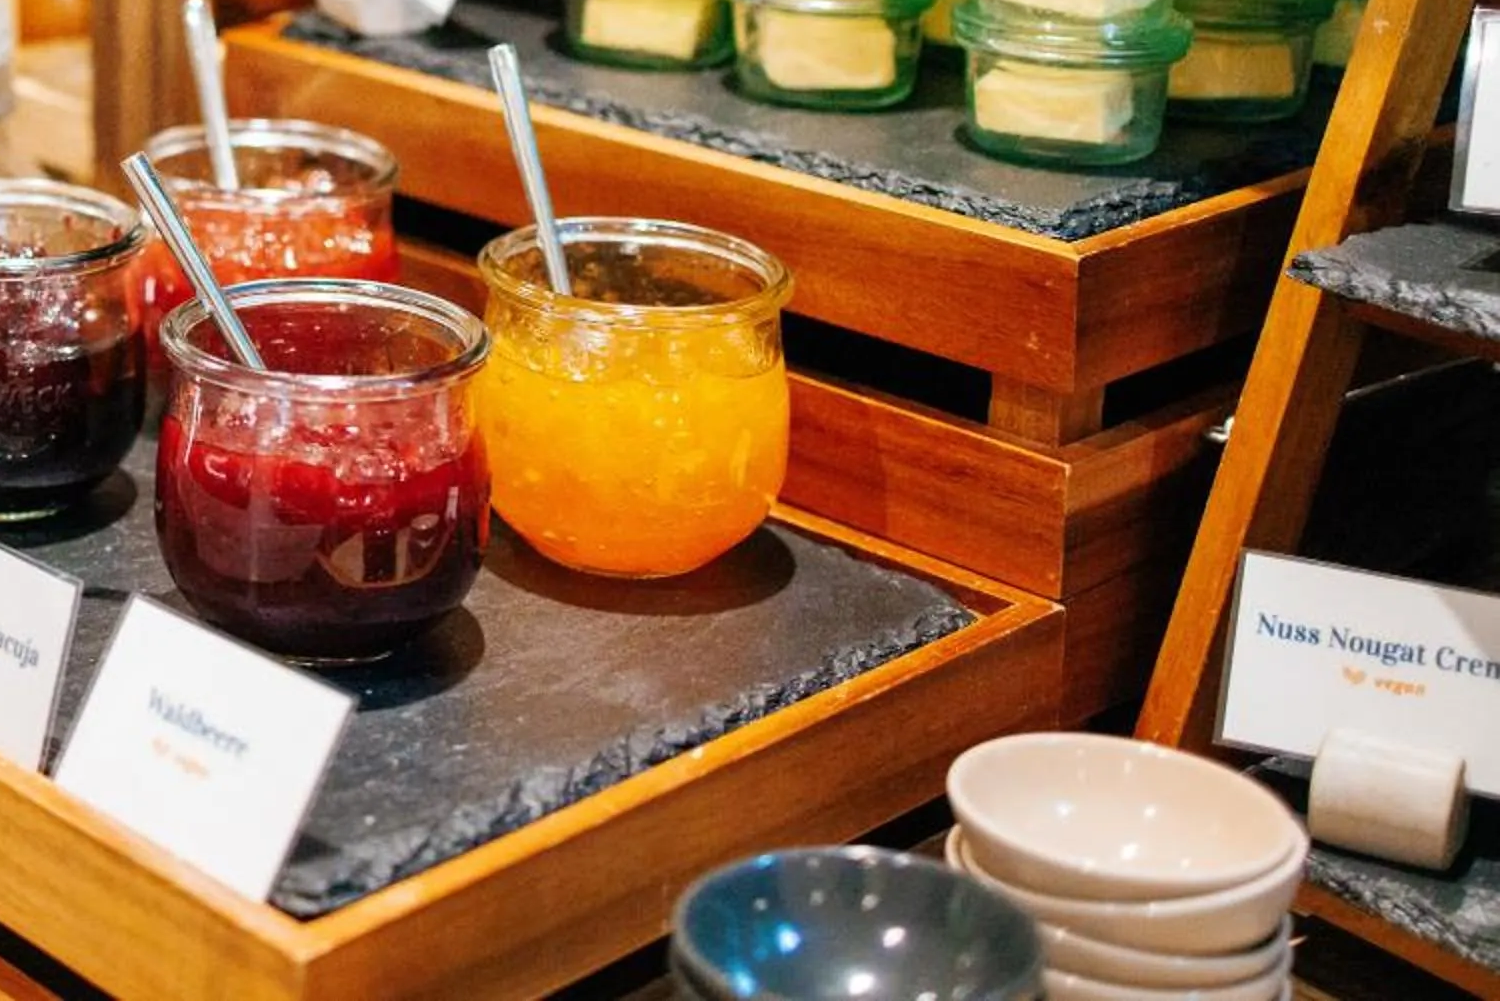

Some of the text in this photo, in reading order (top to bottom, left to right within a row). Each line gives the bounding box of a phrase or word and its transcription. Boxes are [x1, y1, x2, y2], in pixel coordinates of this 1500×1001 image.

[1255, 612, 1321, 645] Nuss
[1327, 626, 1427, 666] Nougat
[1373, 677, 1427, 697] vegan
